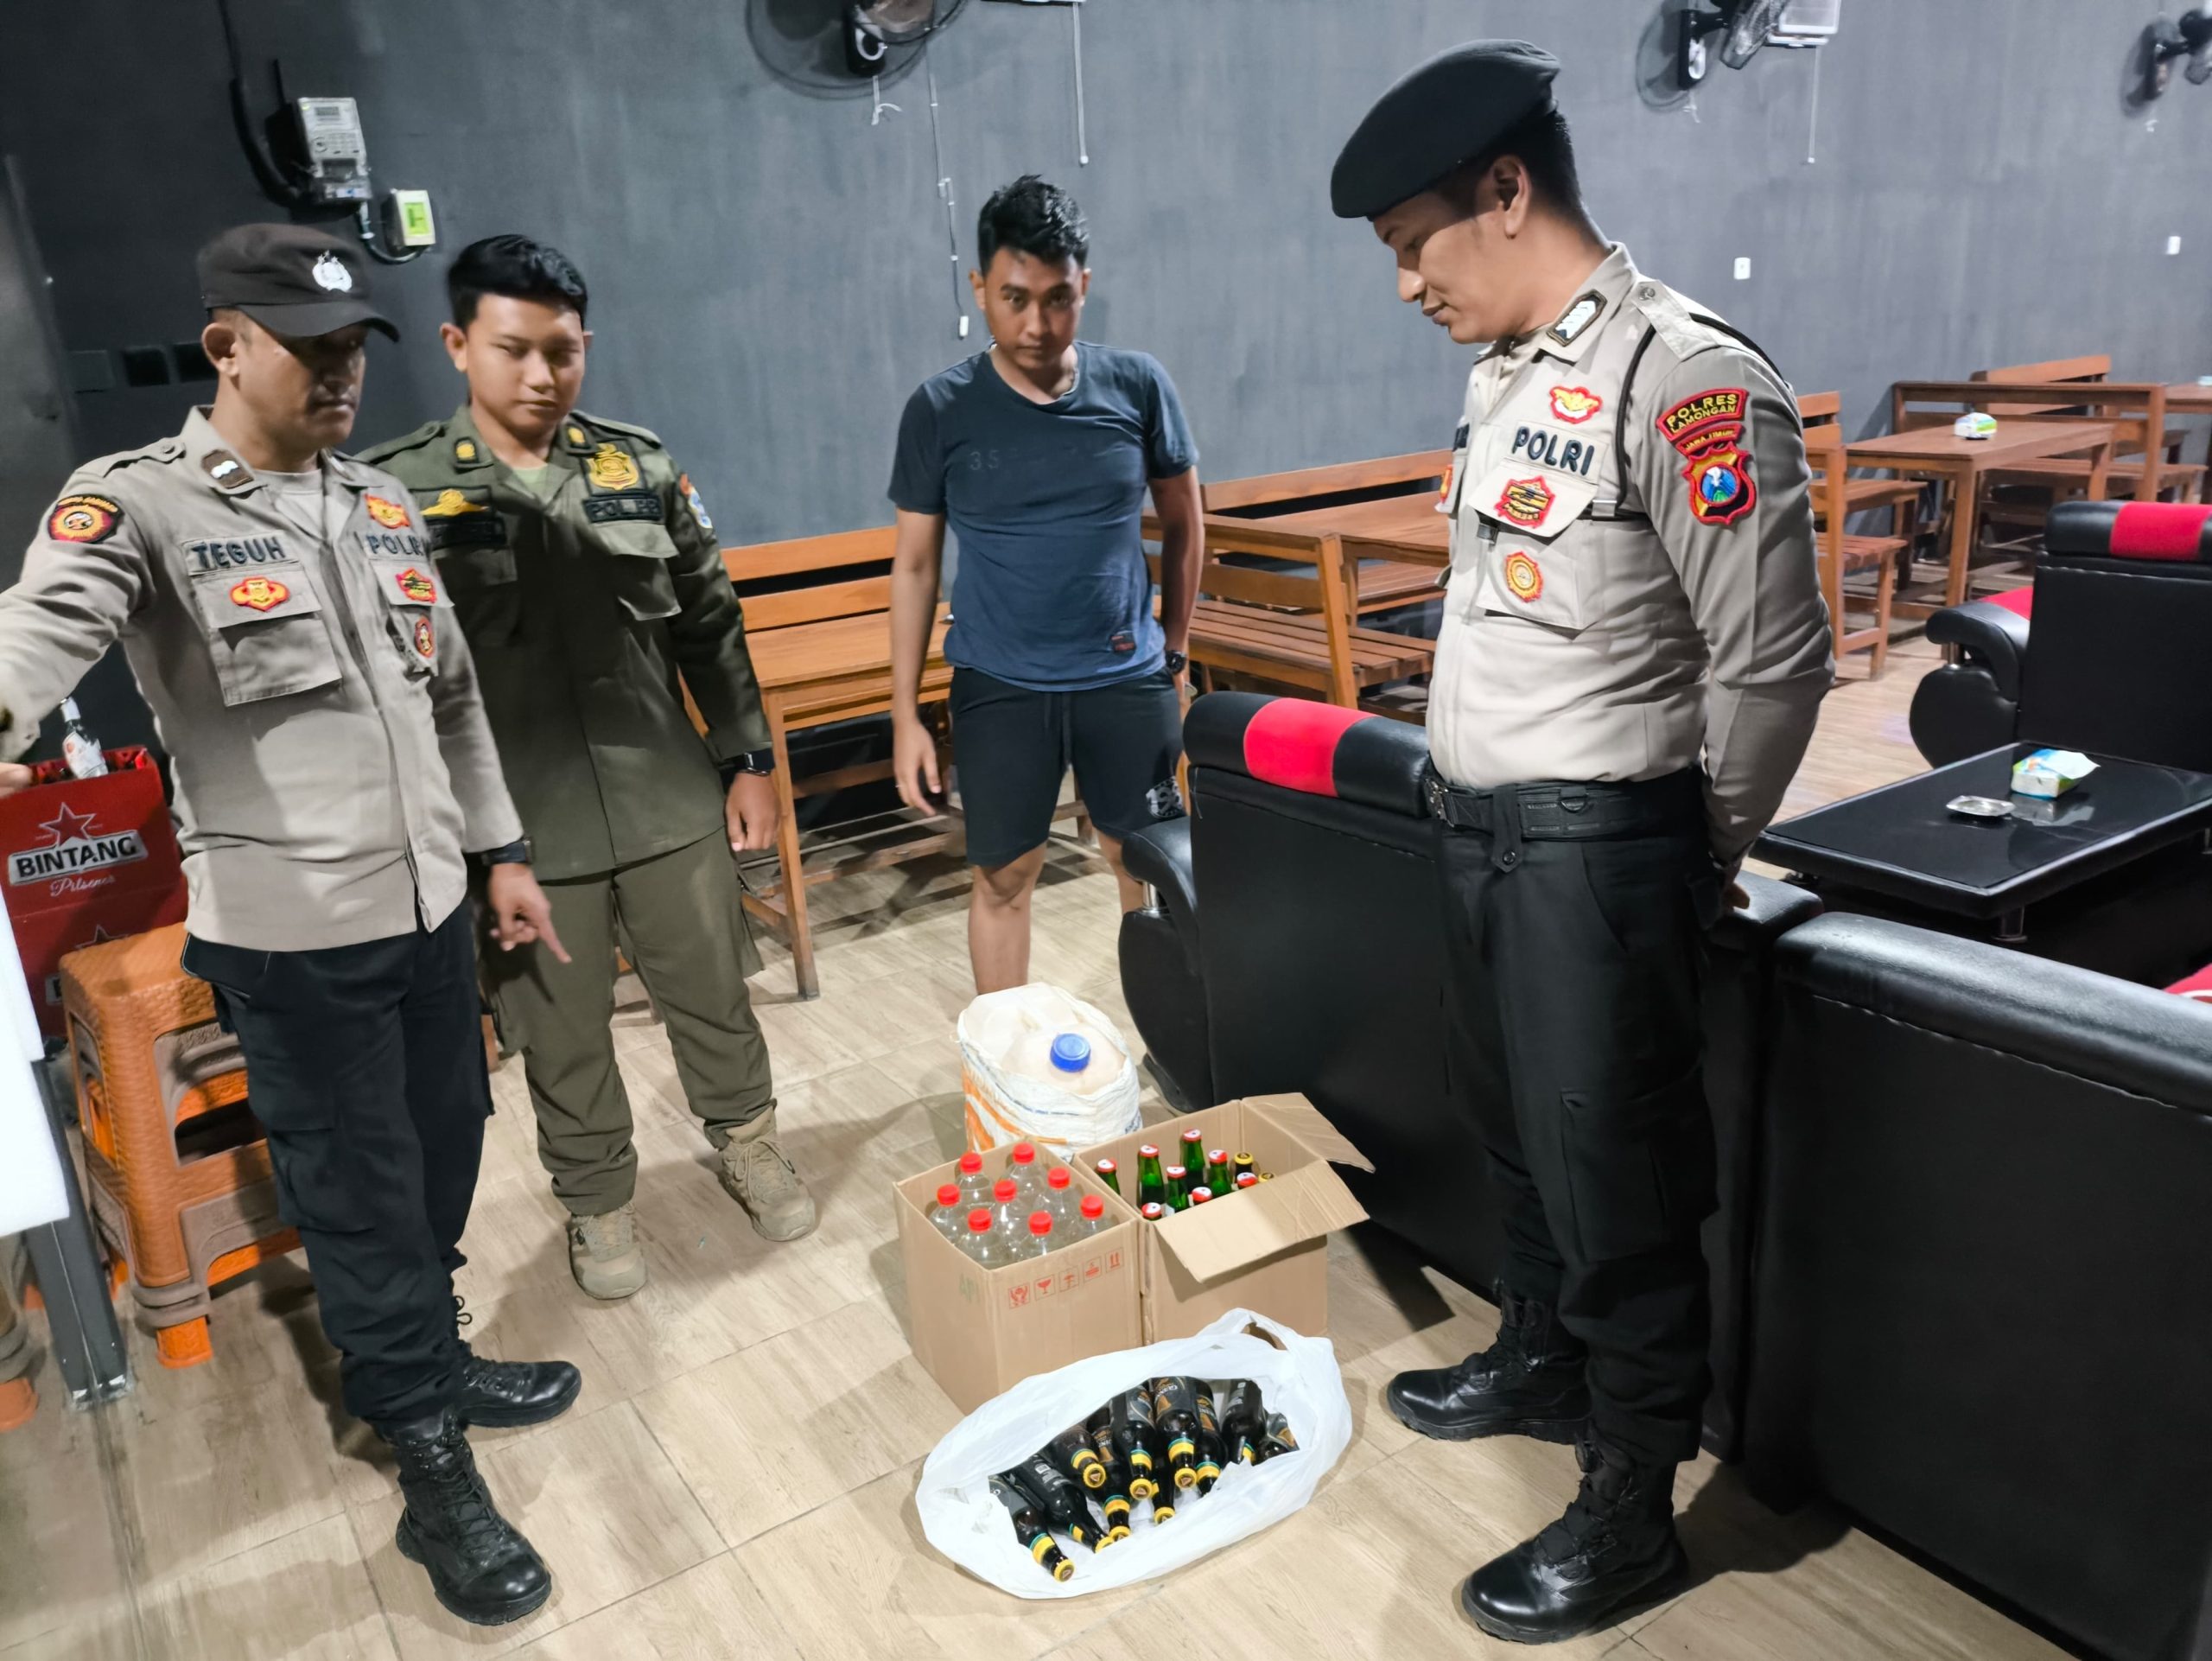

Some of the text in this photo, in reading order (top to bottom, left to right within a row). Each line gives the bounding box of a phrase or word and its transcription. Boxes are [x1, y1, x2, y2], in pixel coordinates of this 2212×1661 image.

[1667, 394, 1737, 428] POLRES
[1670, 405, 1736, 433] LAMONGAN
[1511, 426, 1595, 476] POLRI
[190, 537, 286, 569] TEGUH
[16, 837, 137, 878] BINTANG
